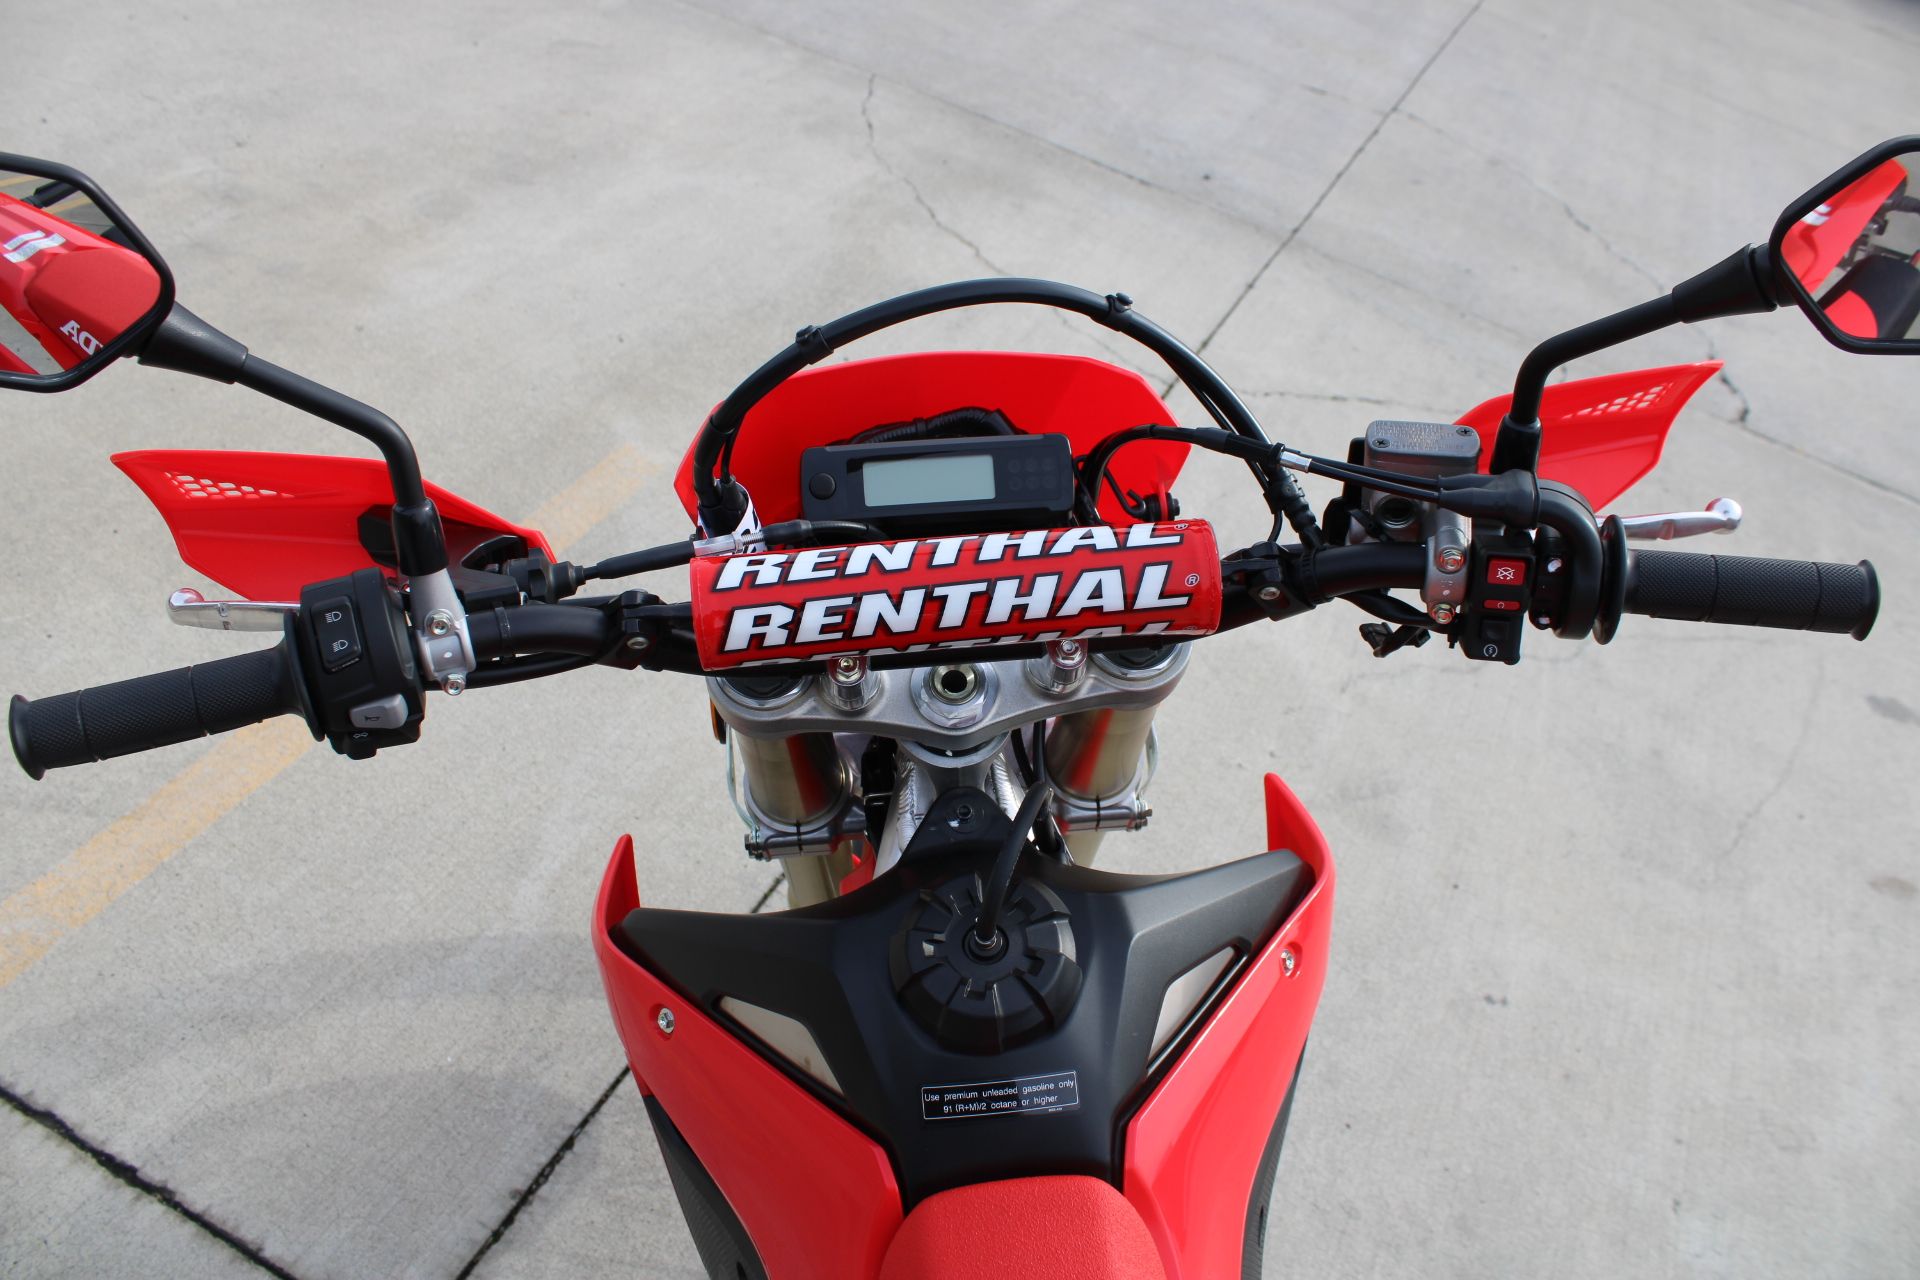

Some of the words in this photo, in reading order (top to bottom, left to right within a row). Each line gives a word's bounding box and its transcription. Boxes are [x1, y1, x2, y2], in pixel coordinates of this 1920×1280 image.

[715, 523, 1182, 590] RENTHAL
[723, 564, 1192, 652] RENTHAL
[924, 1093, 940, 1102] Use
[944, 1090, 978, 1102] premium
[982, 1086, 1018, 1098] unleaded
[1022, 1082, 1055, 1095] gasoline
[1058, 1079, 1075, 1090] only
[943, 1105, 953, 1113] 91
[955, 1102, 987, 1114] (R+M)/2
[990, 1099, 1018, 1109] octane
[1021, 1098, 1030, 1107] or
[1033, 1093, 1058, 1105] higher
